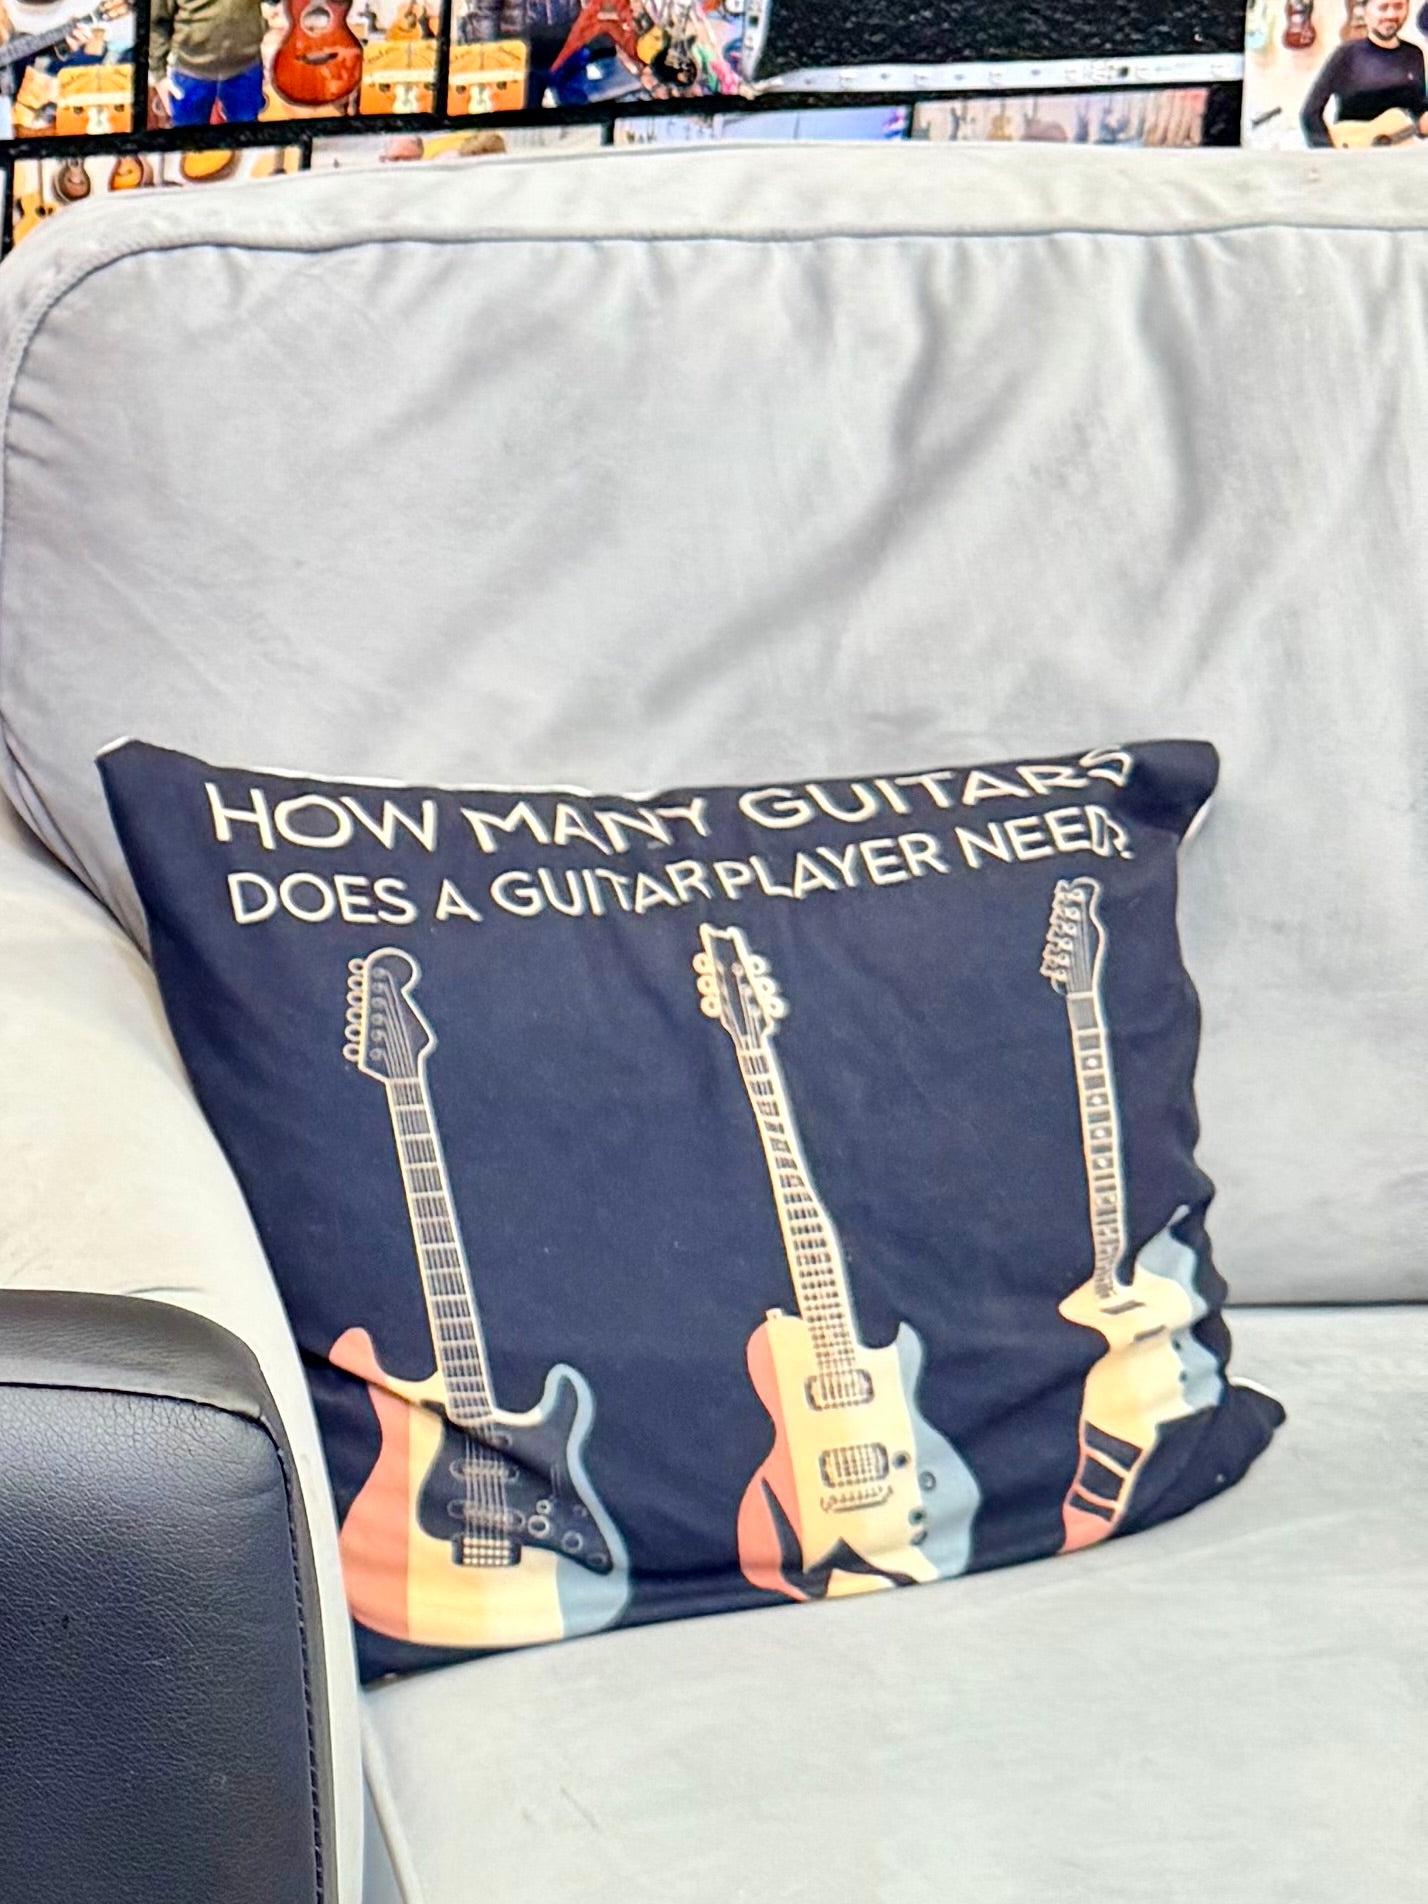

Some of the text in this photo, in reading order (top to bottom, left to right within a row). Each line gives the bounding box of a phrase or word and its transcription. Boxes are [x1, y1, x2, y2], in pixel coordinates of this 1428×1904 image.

[205, 744, 1134, 856] HOW MANY GUITARS
[227, 870, 419, 925] DOES
[435, 877, 484, 923] A
